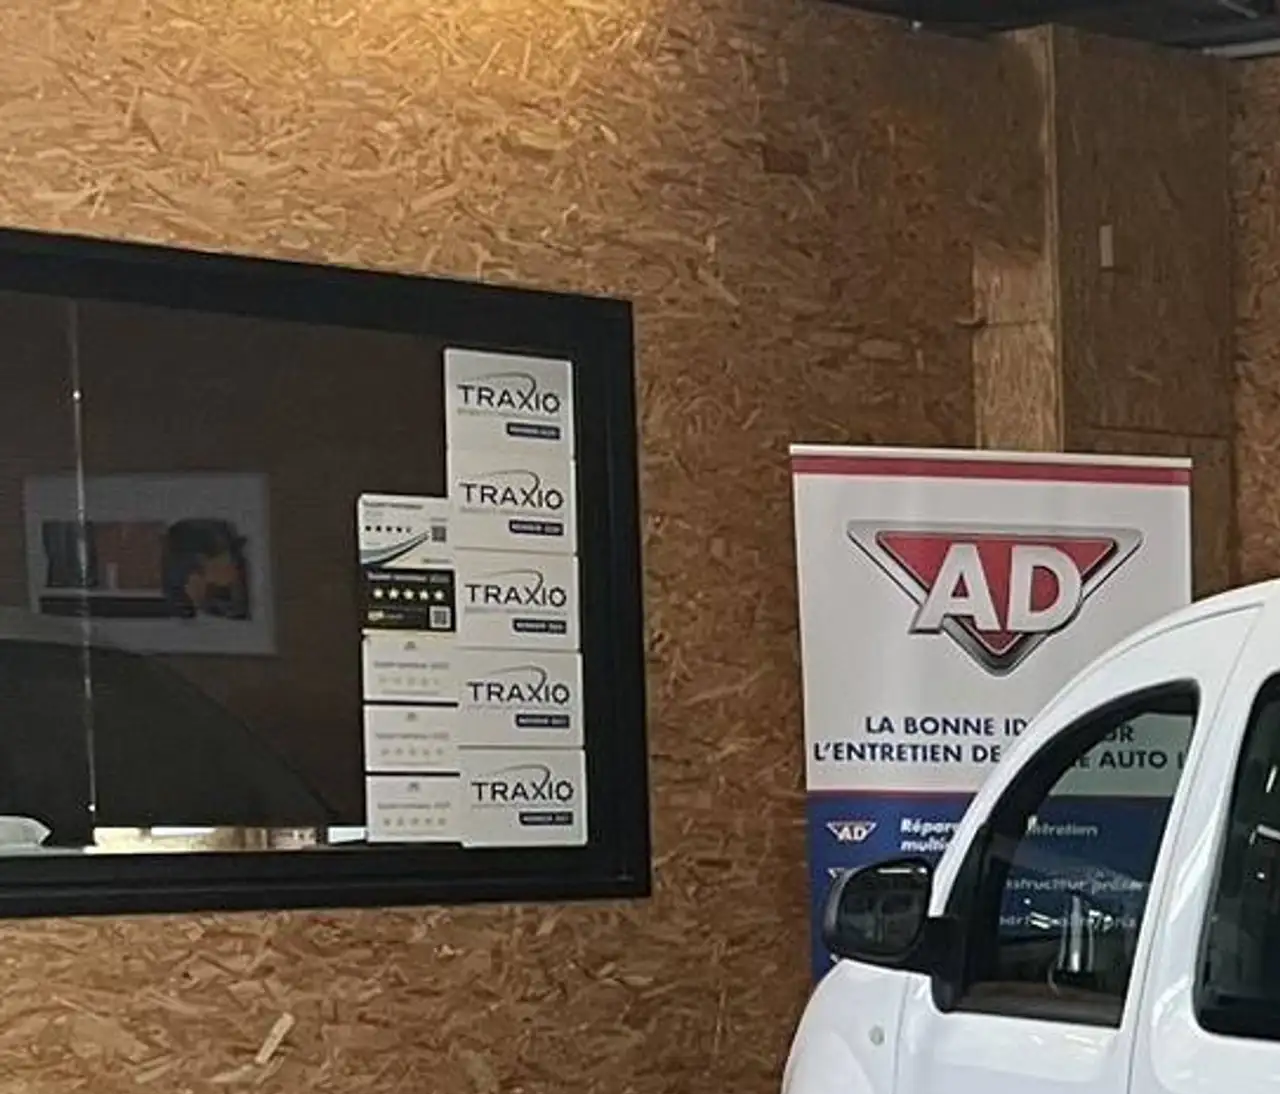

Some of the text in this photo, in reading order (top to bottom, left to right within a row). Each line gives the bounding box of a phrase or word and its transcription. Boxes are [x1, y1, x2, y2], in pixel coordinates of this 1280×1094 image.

[457, 383, 561, 415] TRAXIO
[460, 481, 564, 511] TRAXIO
[465, 583, 568, 608] TRAXIO
[911, 540, 1086, 634] AD
[467, 680, 571, 706] TRAXIO
[865, 716, 895, 735] LA
[904, 717, 995, 737] BONNE
[1004, 717, 1034, 737] ID
[814, 742, 962, 764] L'ENTRETIEN
[972, 744, 1001, 763] DE
[1100, 750, 1168, 770] AUTO
[471, 779, 575, 804] TRAXIO
[901, 837, 946, 852] multi
